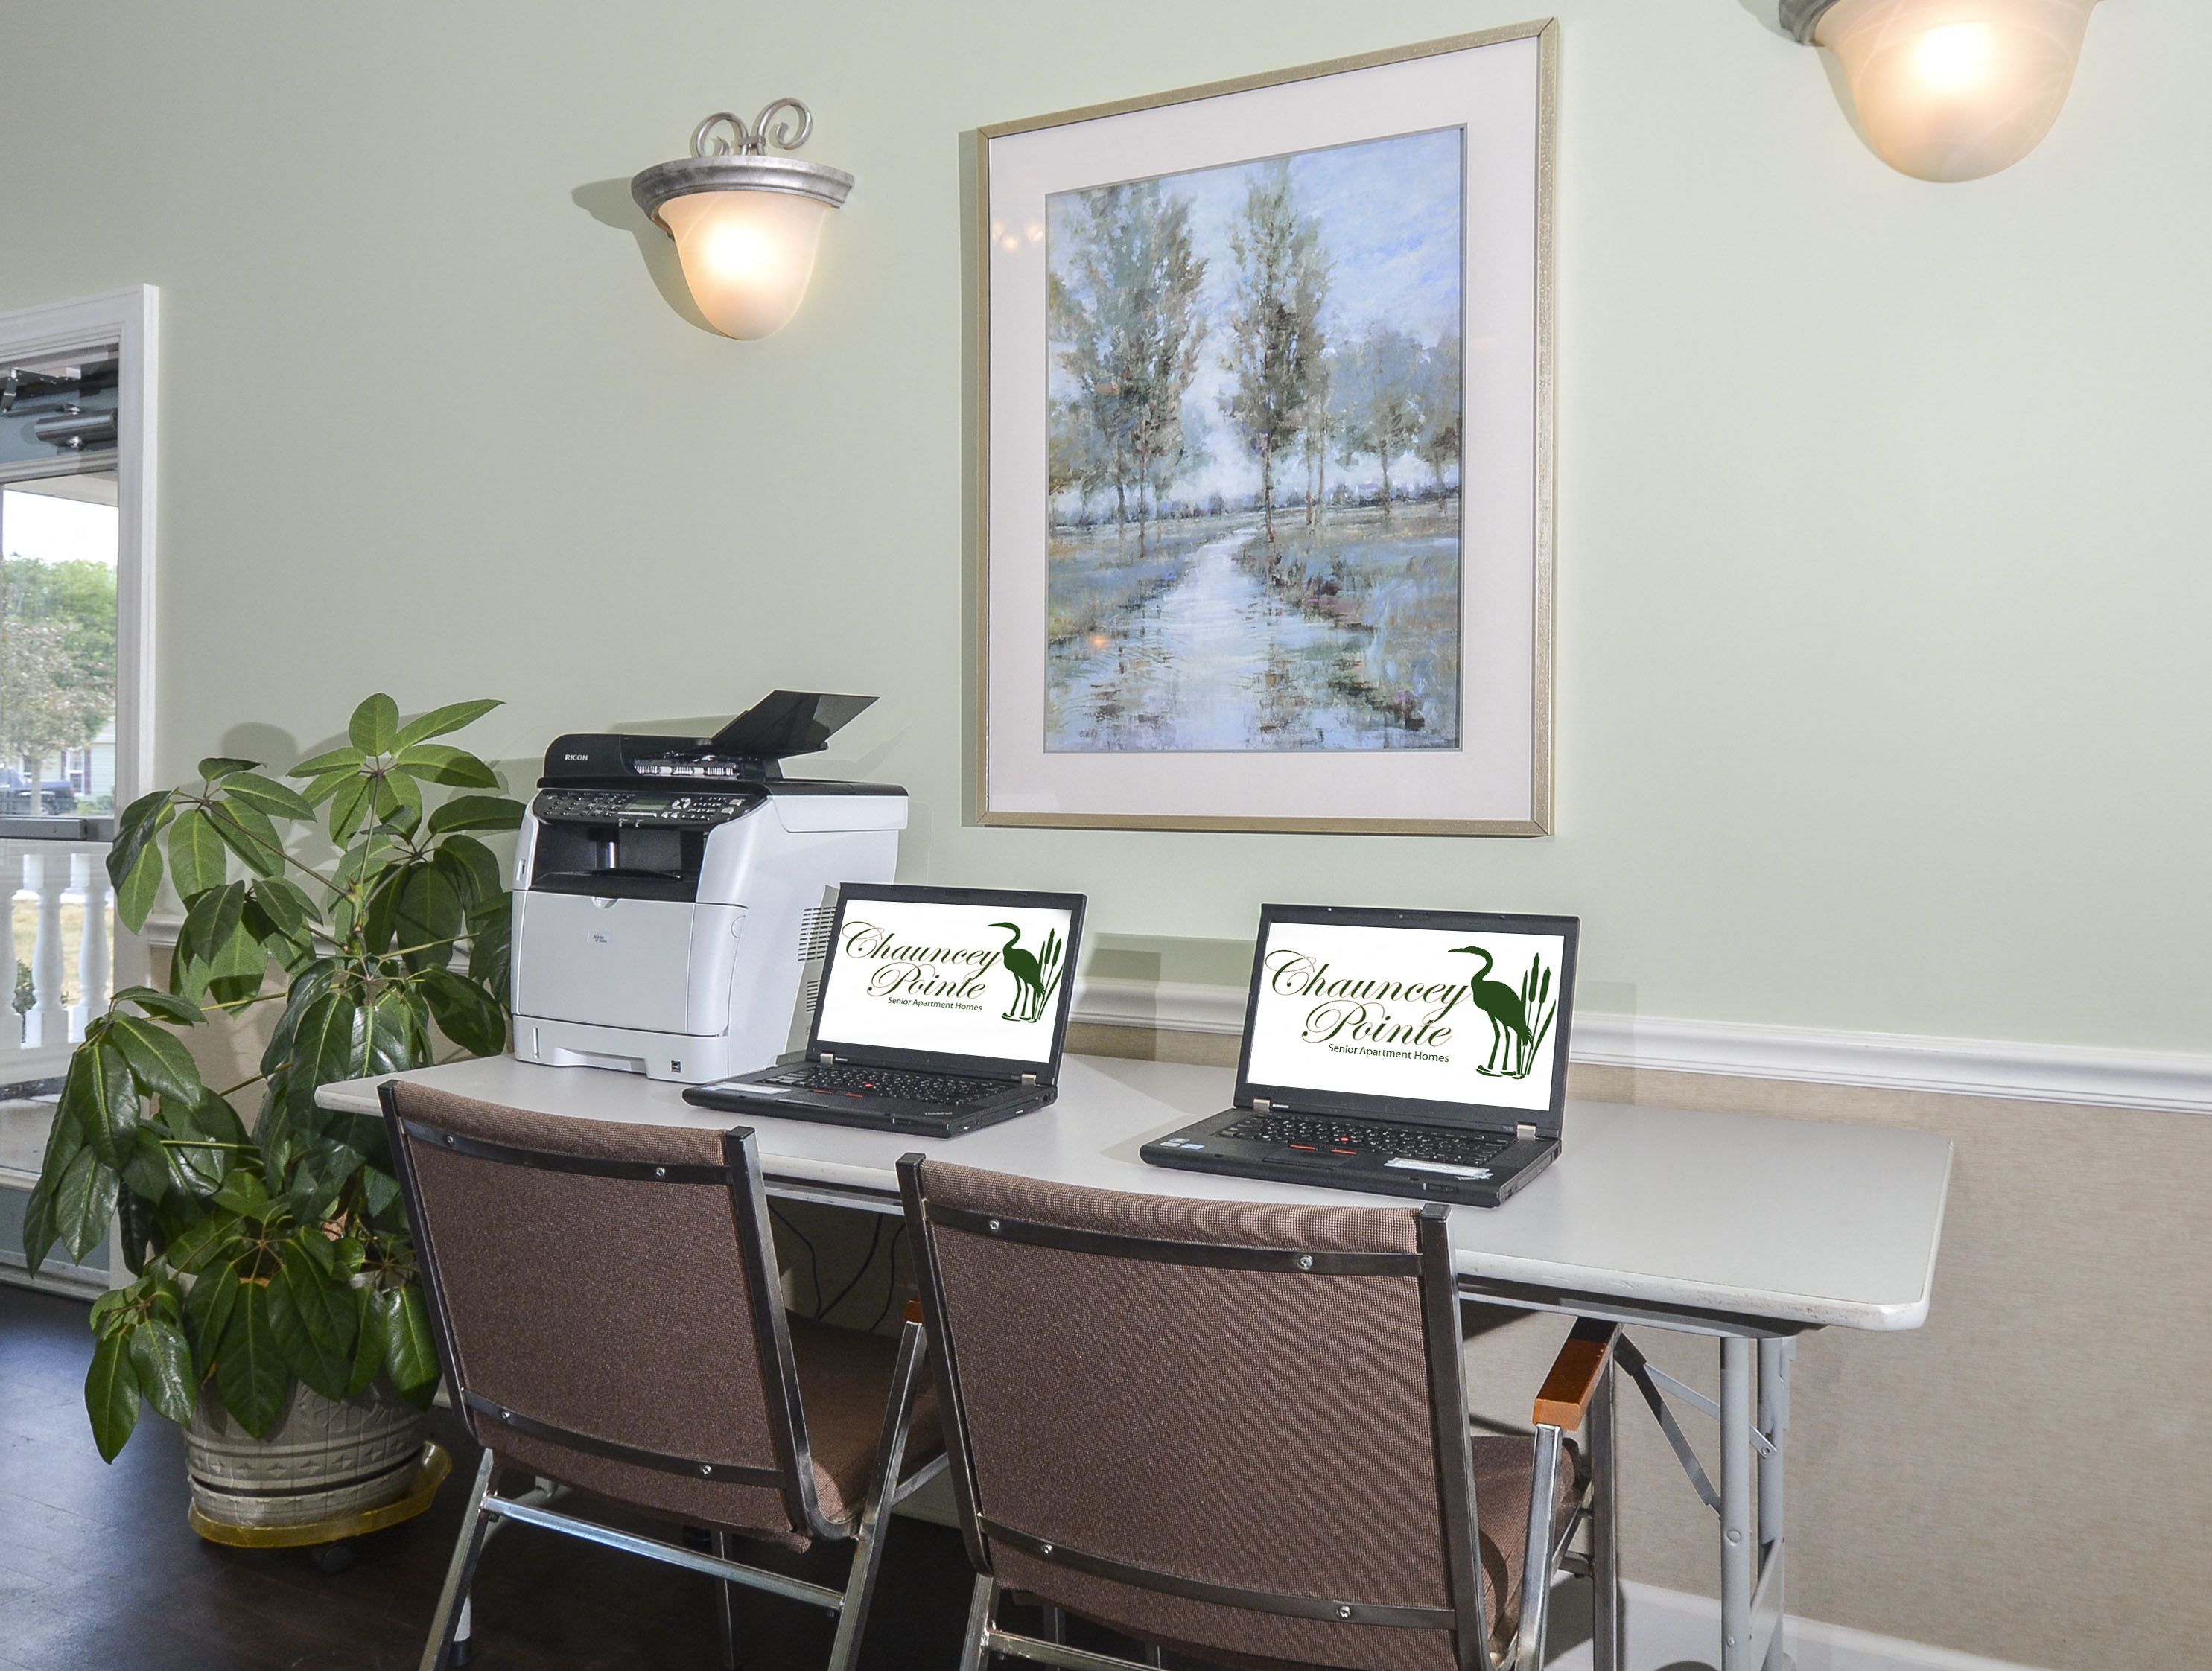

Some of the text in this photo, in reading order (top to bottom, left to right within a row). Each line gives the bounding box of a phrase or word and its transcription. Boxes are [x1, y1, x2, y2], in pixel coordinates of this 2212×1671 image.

[842, 922, 1002, 981] Chauncey
[867, 962, 985, 999] Pointe
[1265, 949, 1472, 1025] Chauncey
[888, 996, 982, 1011] Senior Apartment Homes
[1301, 999, 1452, 1048] Pointe
[1328, 1043, 1450, 1063] Senior Apartment Homes
